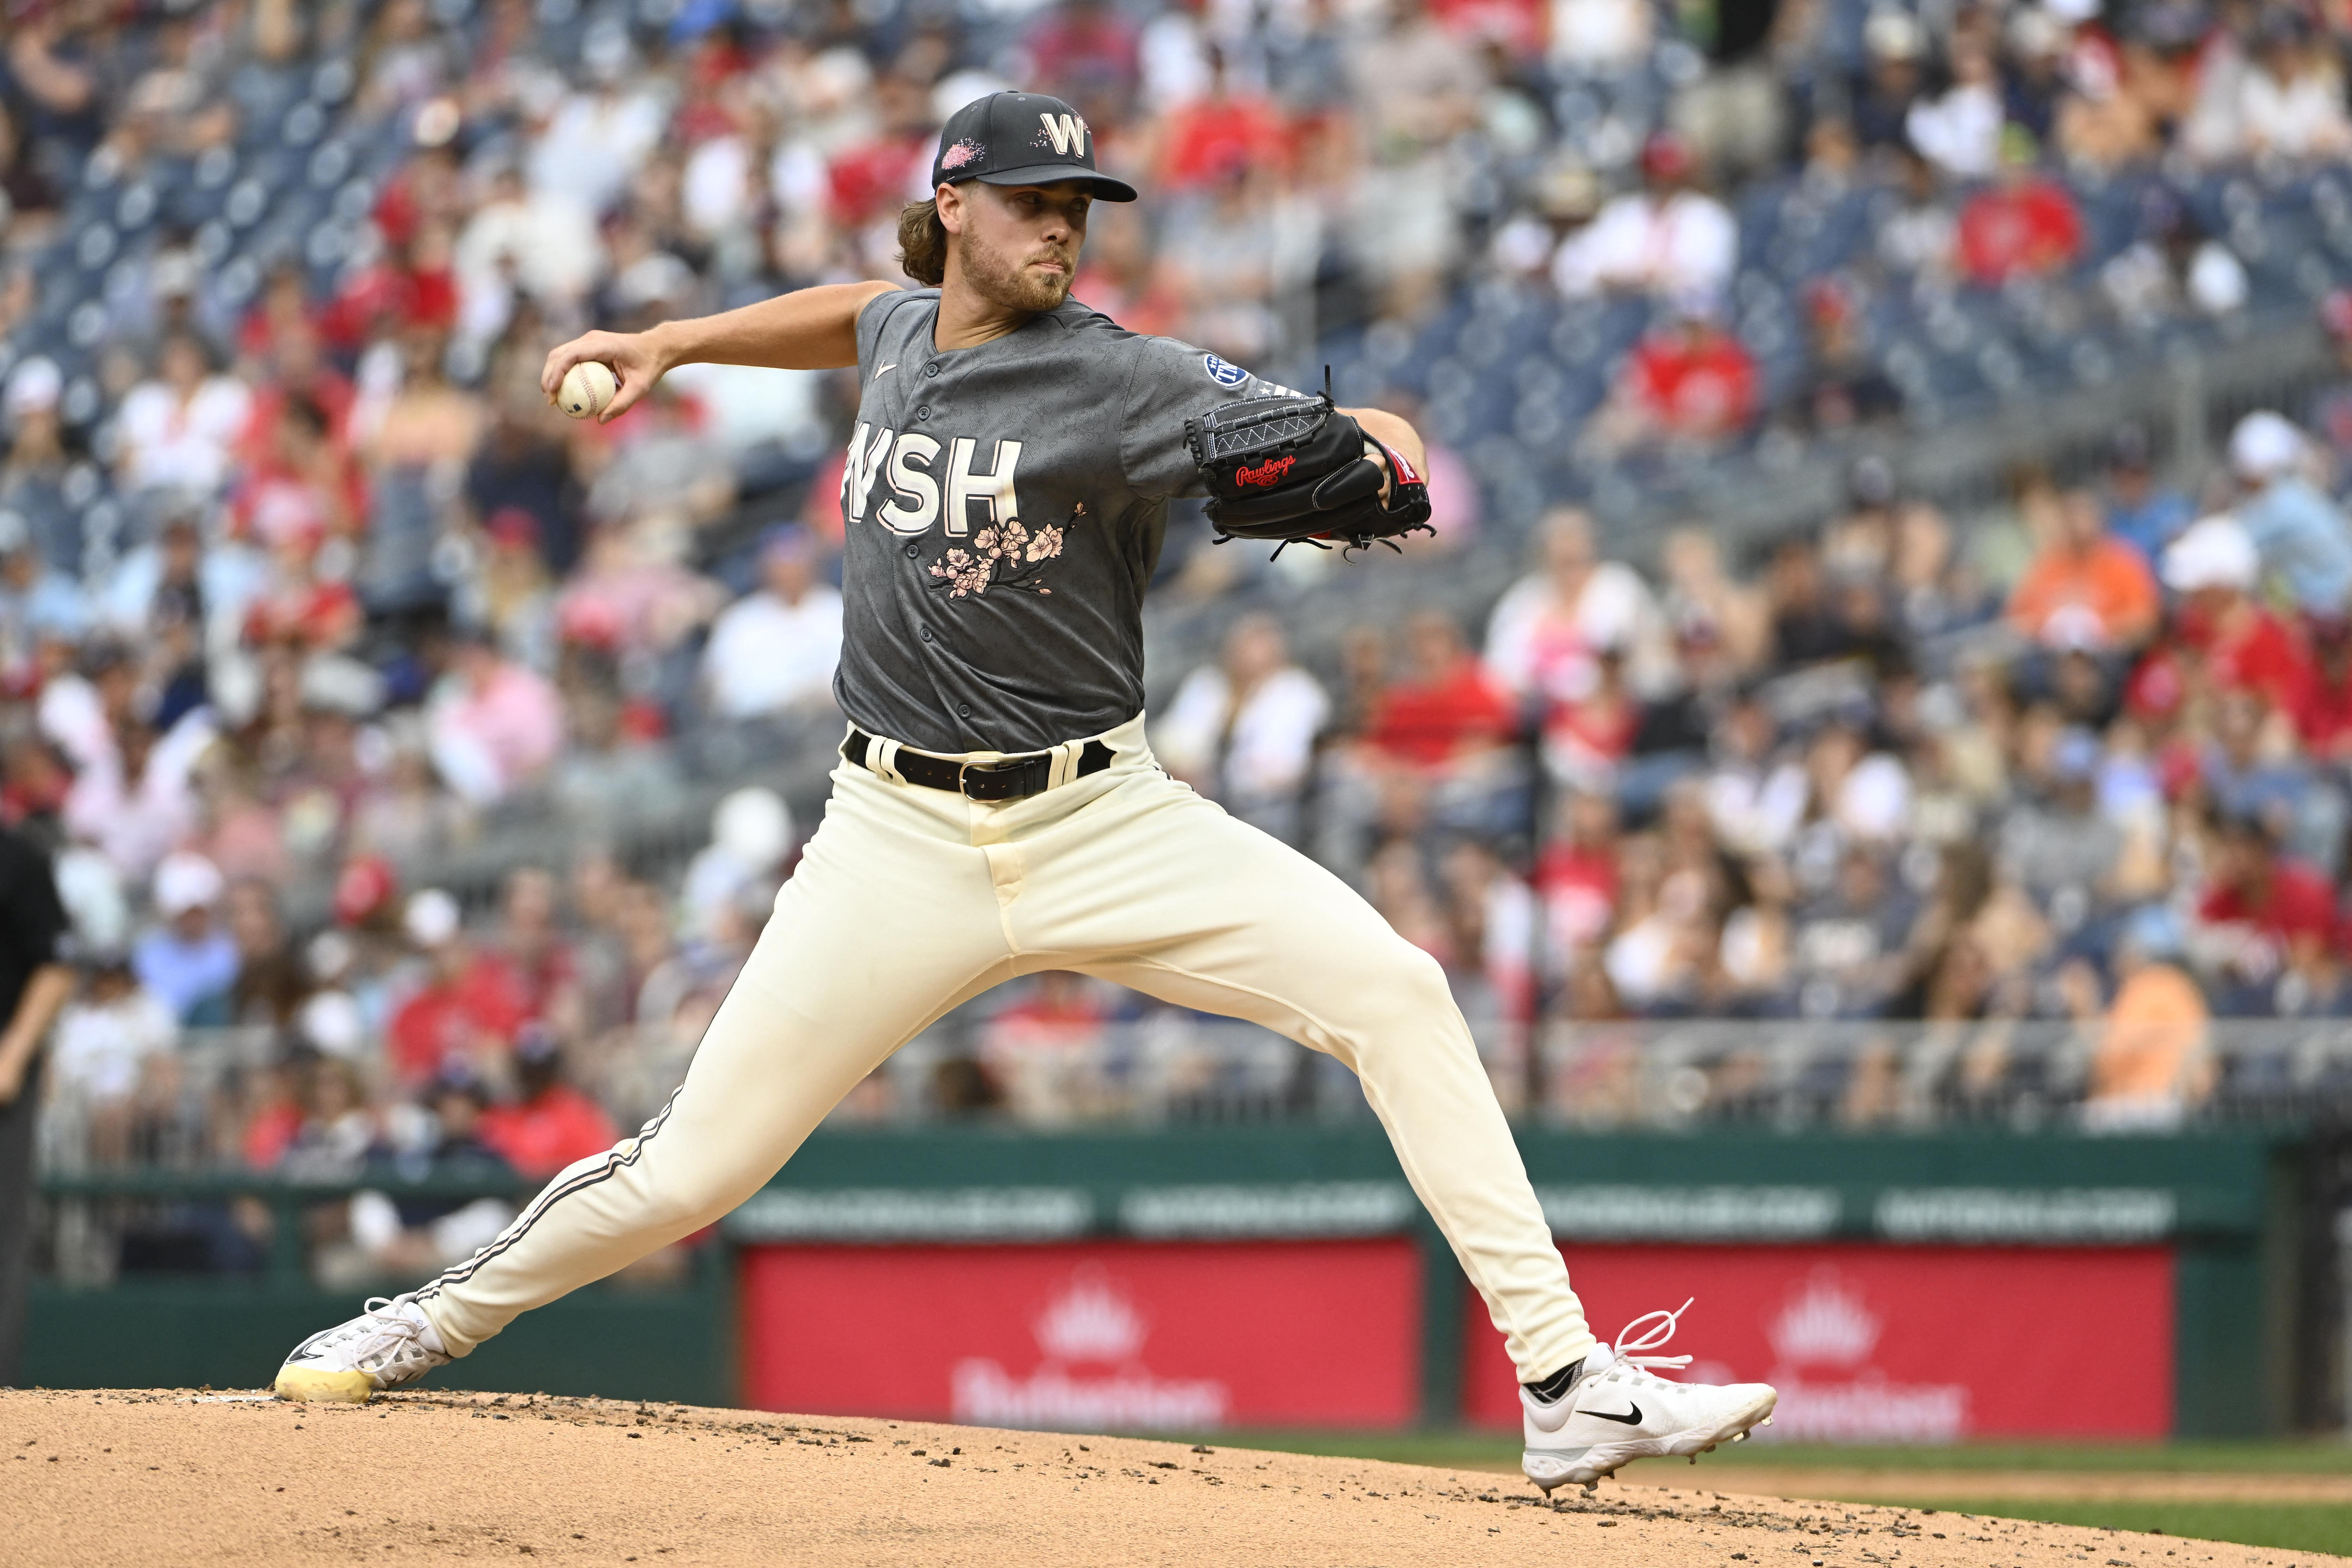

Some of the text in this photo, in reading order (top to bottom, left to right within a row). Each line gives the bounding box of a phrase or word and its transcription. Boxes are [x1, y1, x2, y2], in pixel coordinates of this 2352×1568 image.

[1040, 113, 1084, 158] W
[841, 421, 1023, 537] WSH
[1236, 455, 1296, 487] Rawlings
